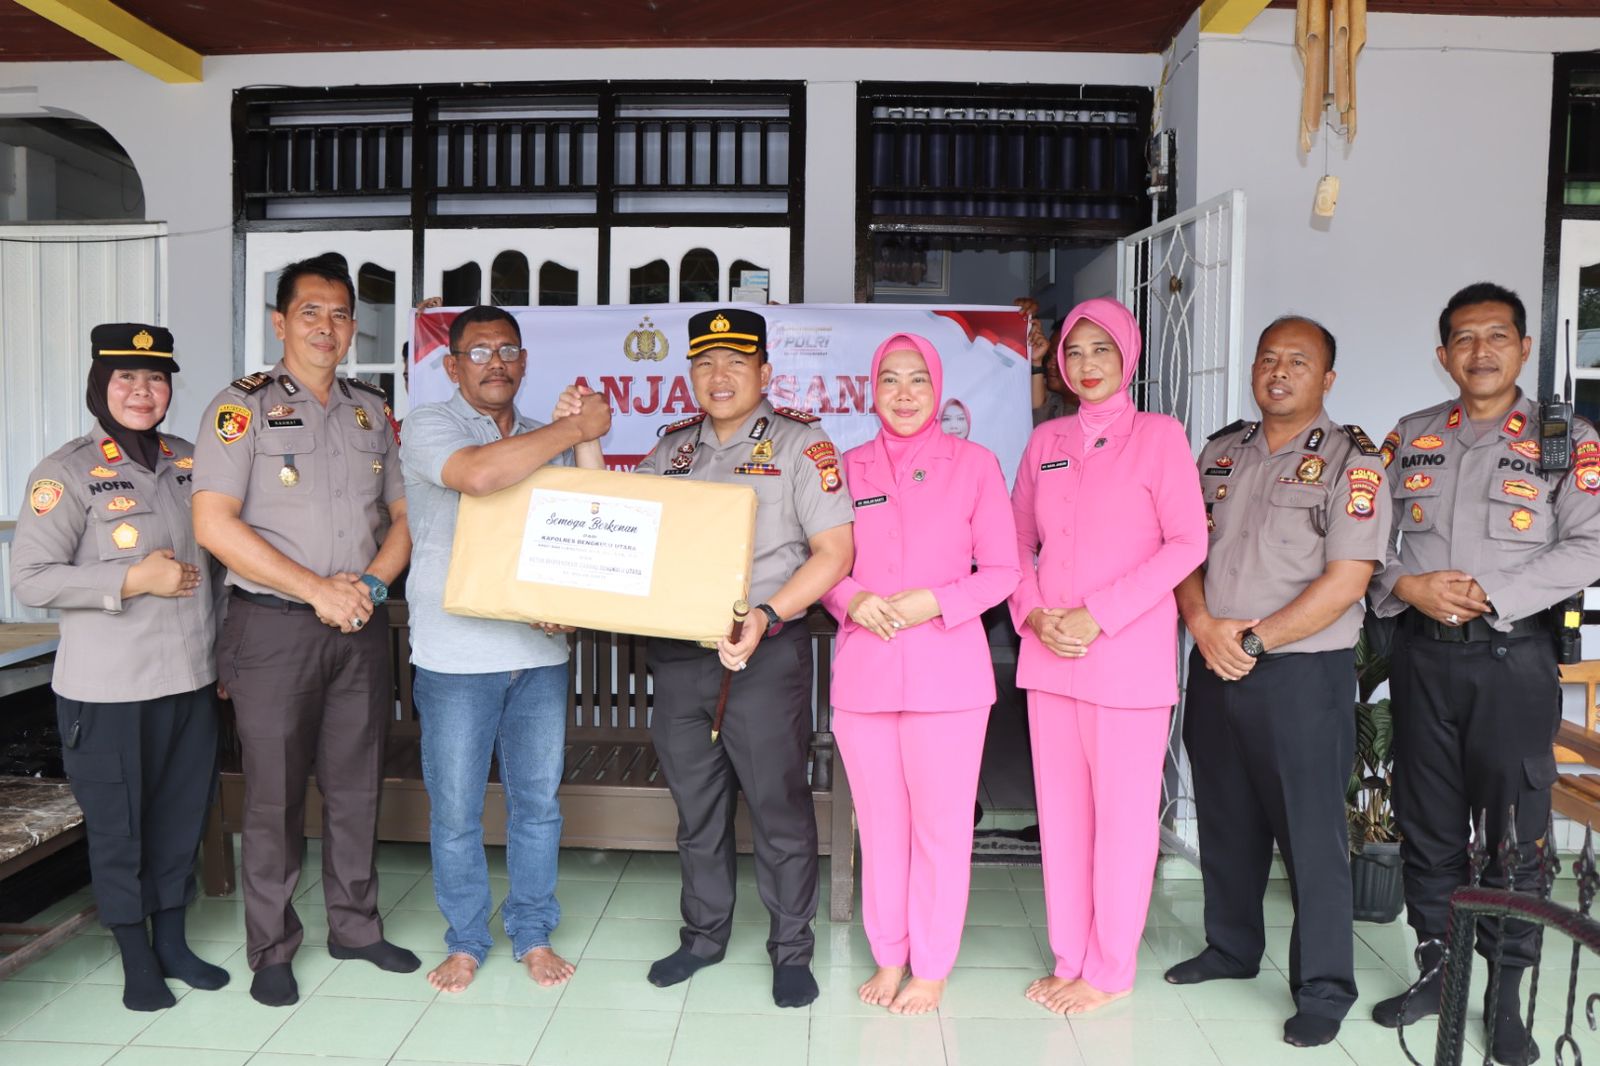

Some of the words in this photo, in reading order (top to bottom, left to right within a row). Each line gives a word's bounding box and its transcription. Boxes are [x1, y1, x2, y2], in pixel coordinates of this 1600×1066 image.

[1401, 453, 1446, 469] RATNO
[1498, 457, 1549, 482] POLRI
[88, 480, 135, 496] NOFRI
[546, 512, 586, 530] Semoga
[588, 517, 638, 533] Berkenan
